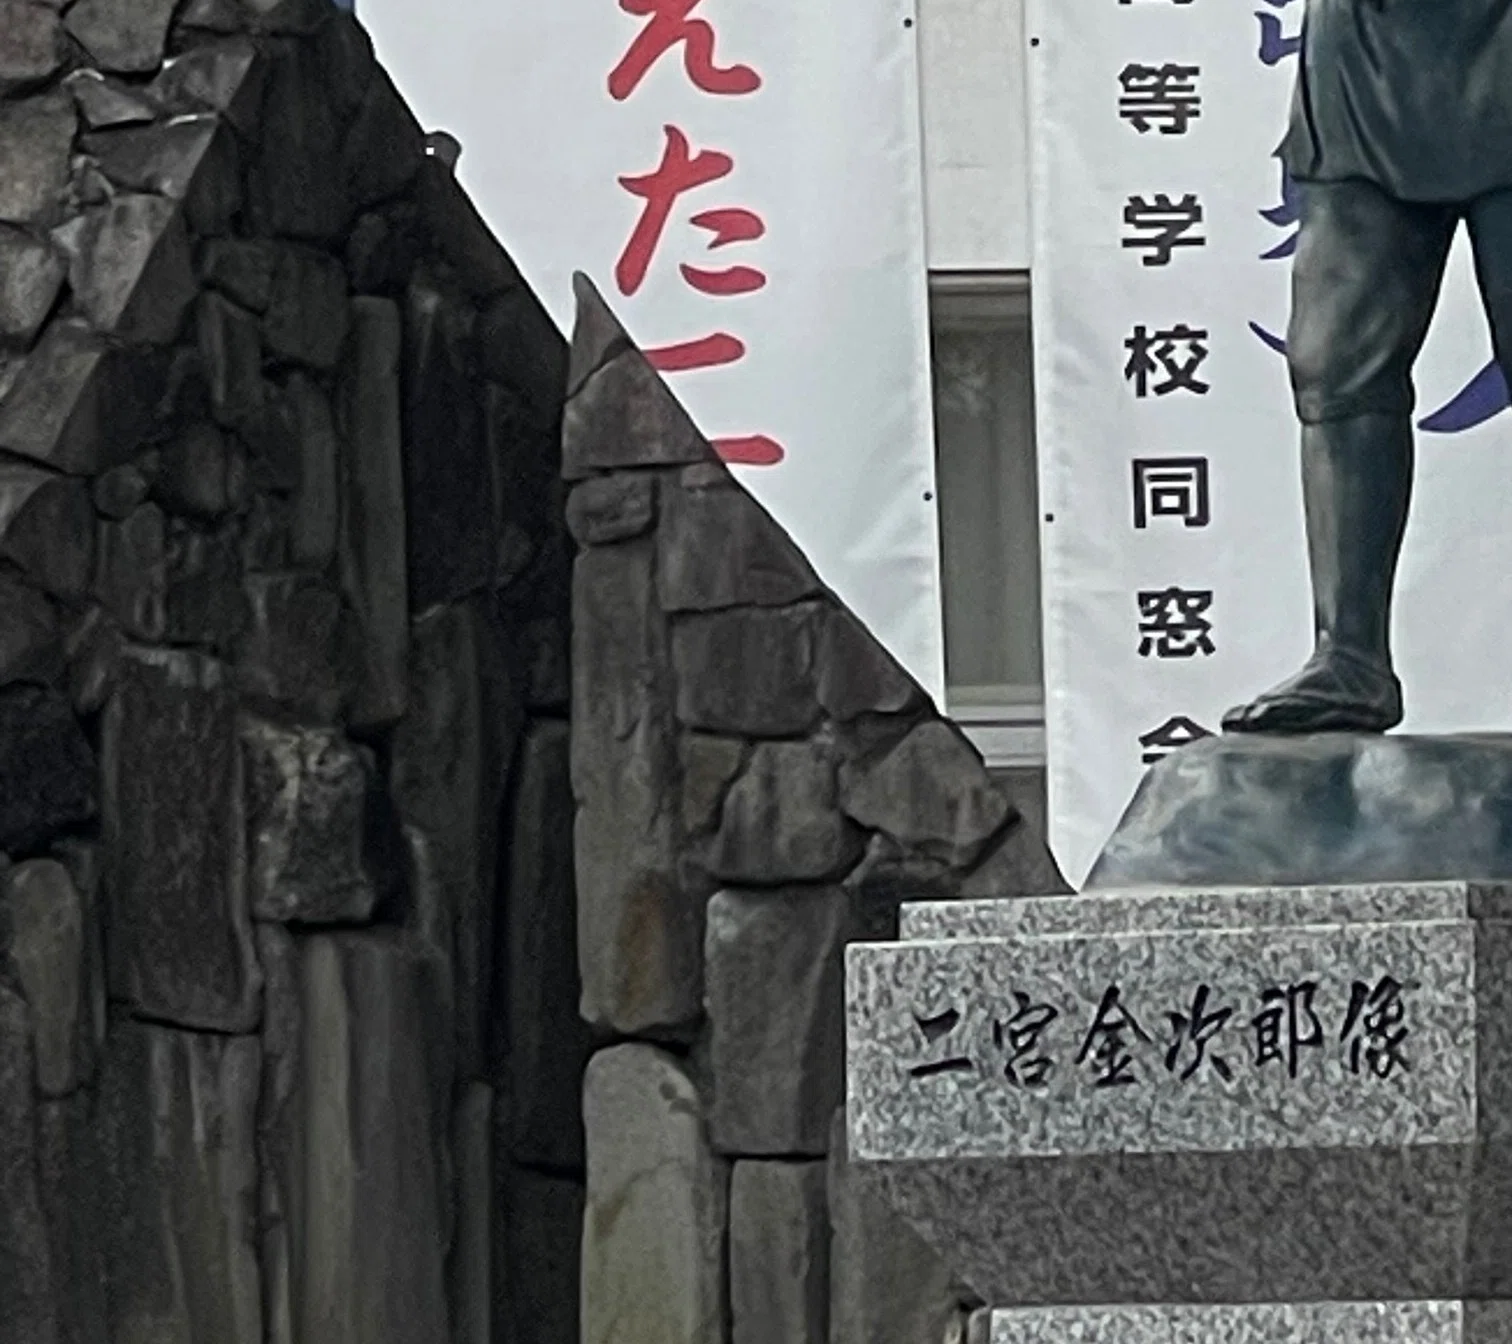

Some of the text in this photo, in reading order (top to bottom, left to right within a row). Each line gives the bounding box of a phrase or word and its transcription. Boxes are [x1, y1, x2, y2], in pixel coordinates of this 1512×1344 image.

[911, 975, 1421, 1087] 二宮金次郎像
